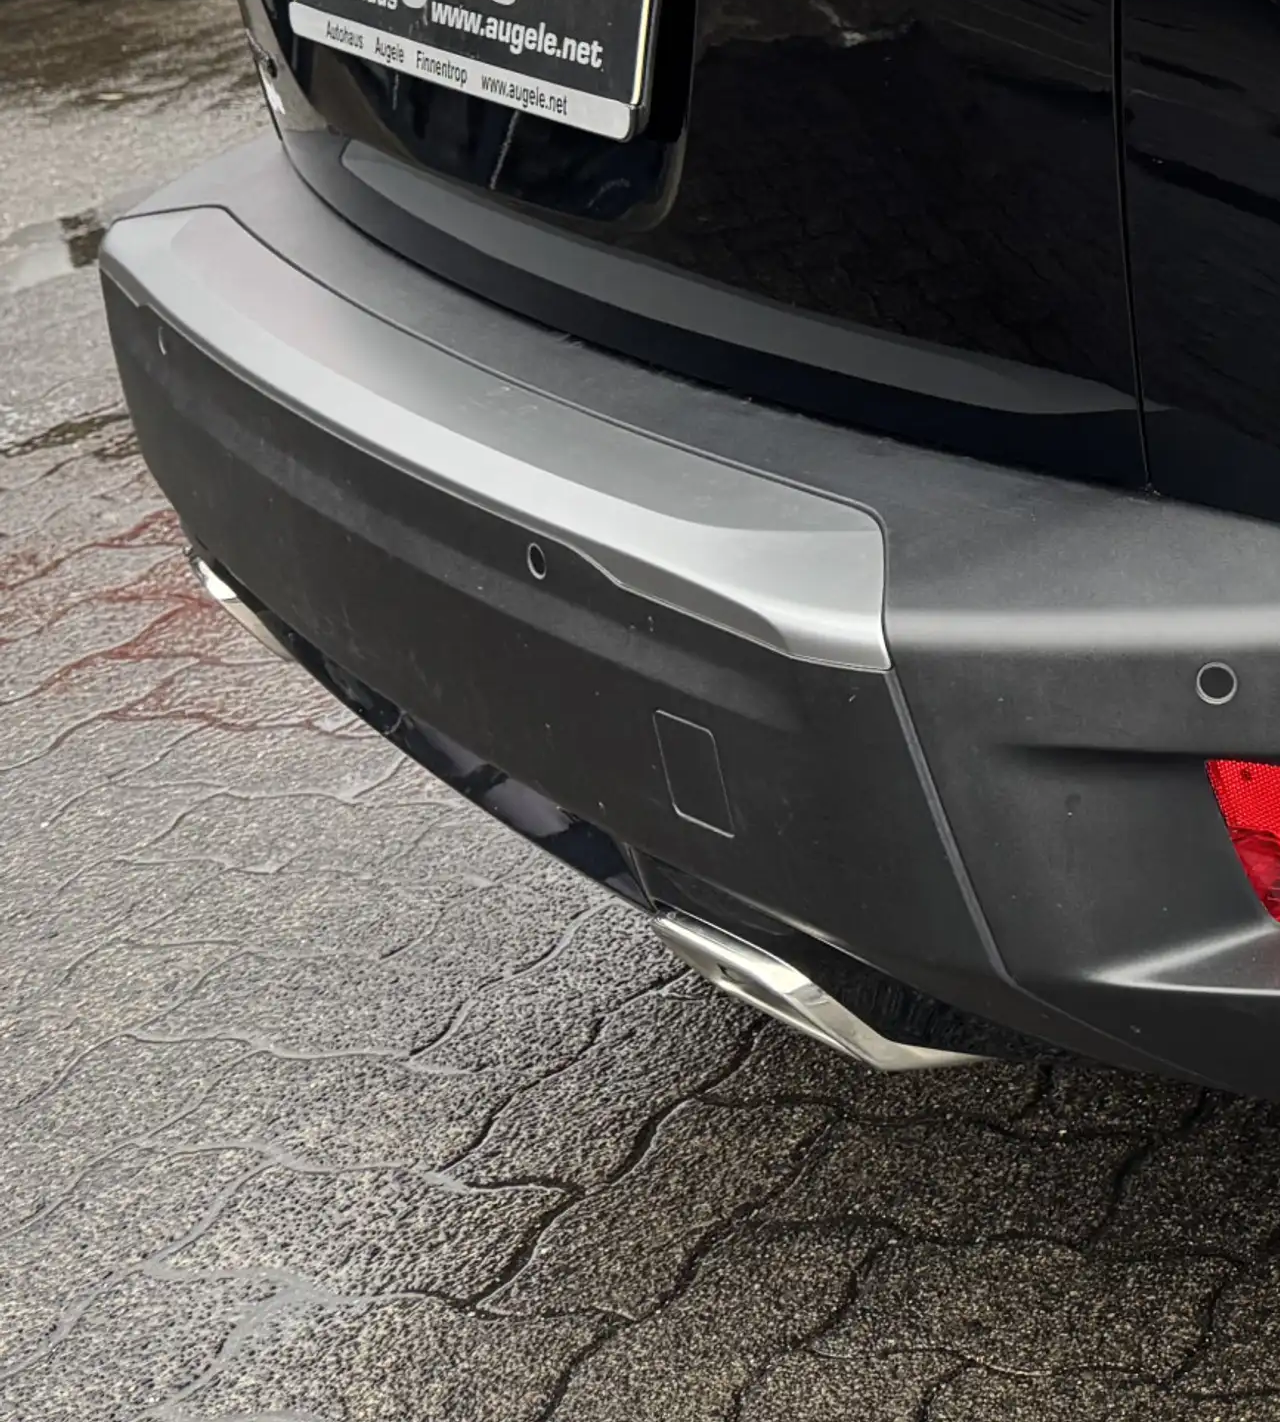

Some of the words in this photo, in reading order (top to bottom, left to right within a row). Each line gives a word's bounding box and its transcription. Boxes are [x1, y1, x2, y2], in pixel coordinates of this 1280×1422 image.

[326, 20, 364, 50] Autohaus
[374, 36, 404, 66] Augele
[416, 50, 468, 85] Finnentrop
[481, 74, 568, 116] www.augele.net
[431, 0, 604, 69] www.augele.net
